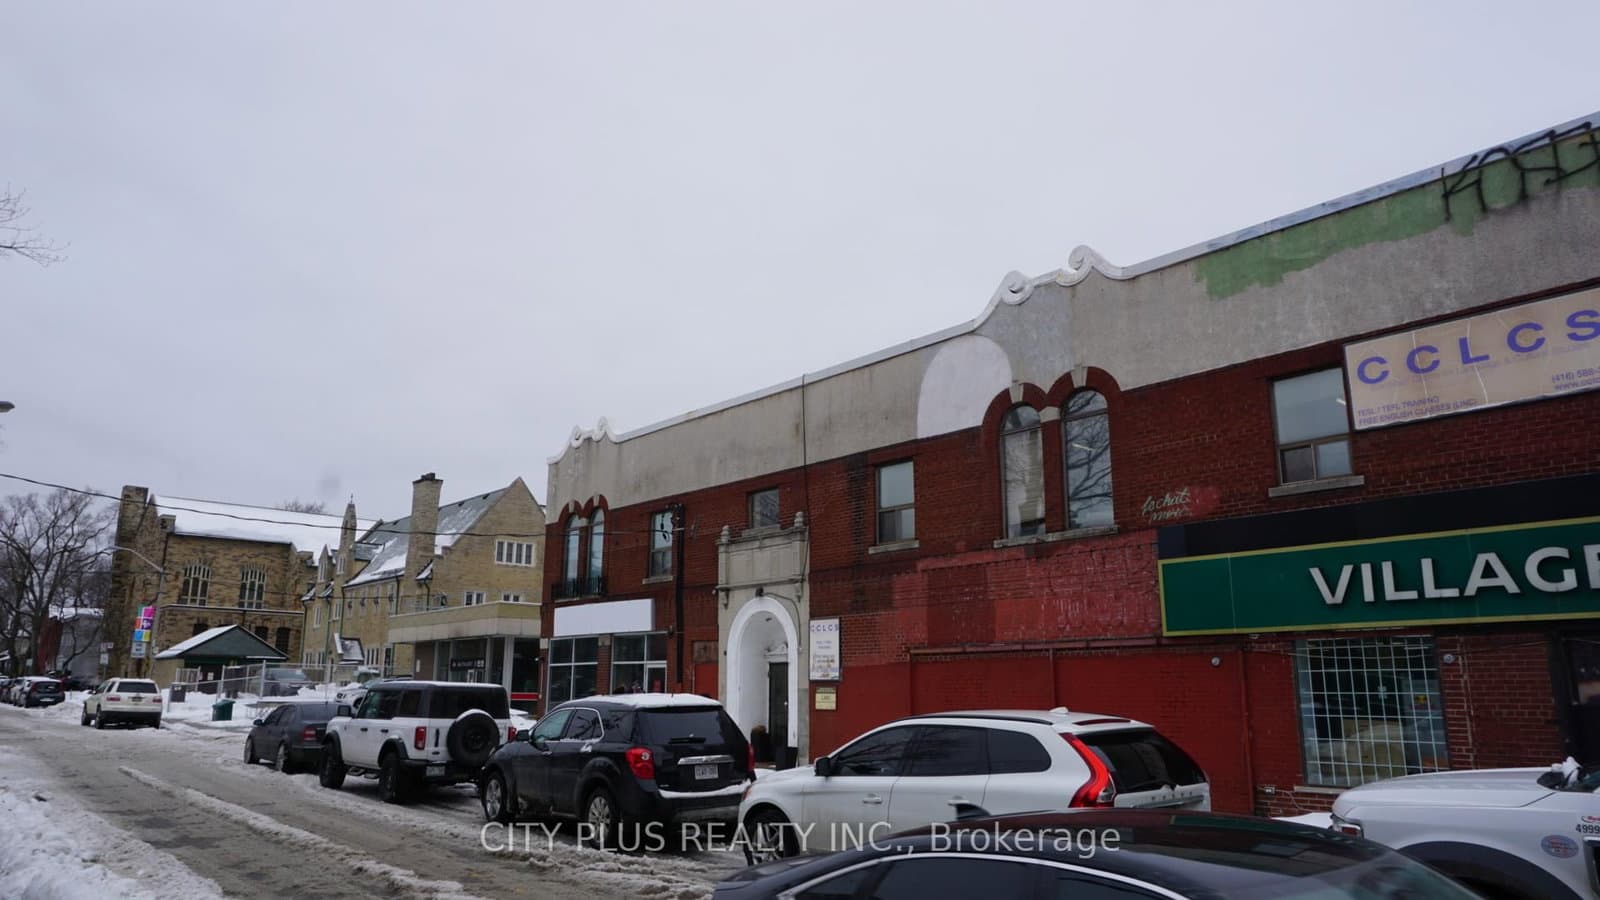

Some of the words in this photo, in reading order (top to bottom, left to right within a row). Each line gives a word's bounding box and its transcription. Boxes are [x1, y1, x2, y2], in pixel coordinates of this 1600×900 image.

[1577, 367, 1600, 378] 588-
[1402, 395, 1440, 409] TRAINING
[1359, 415, 1379, 425] FREE
[1380, 409, 1413, 422] ENGLISH
[1414, 403, 1451, 417] CLASSES
